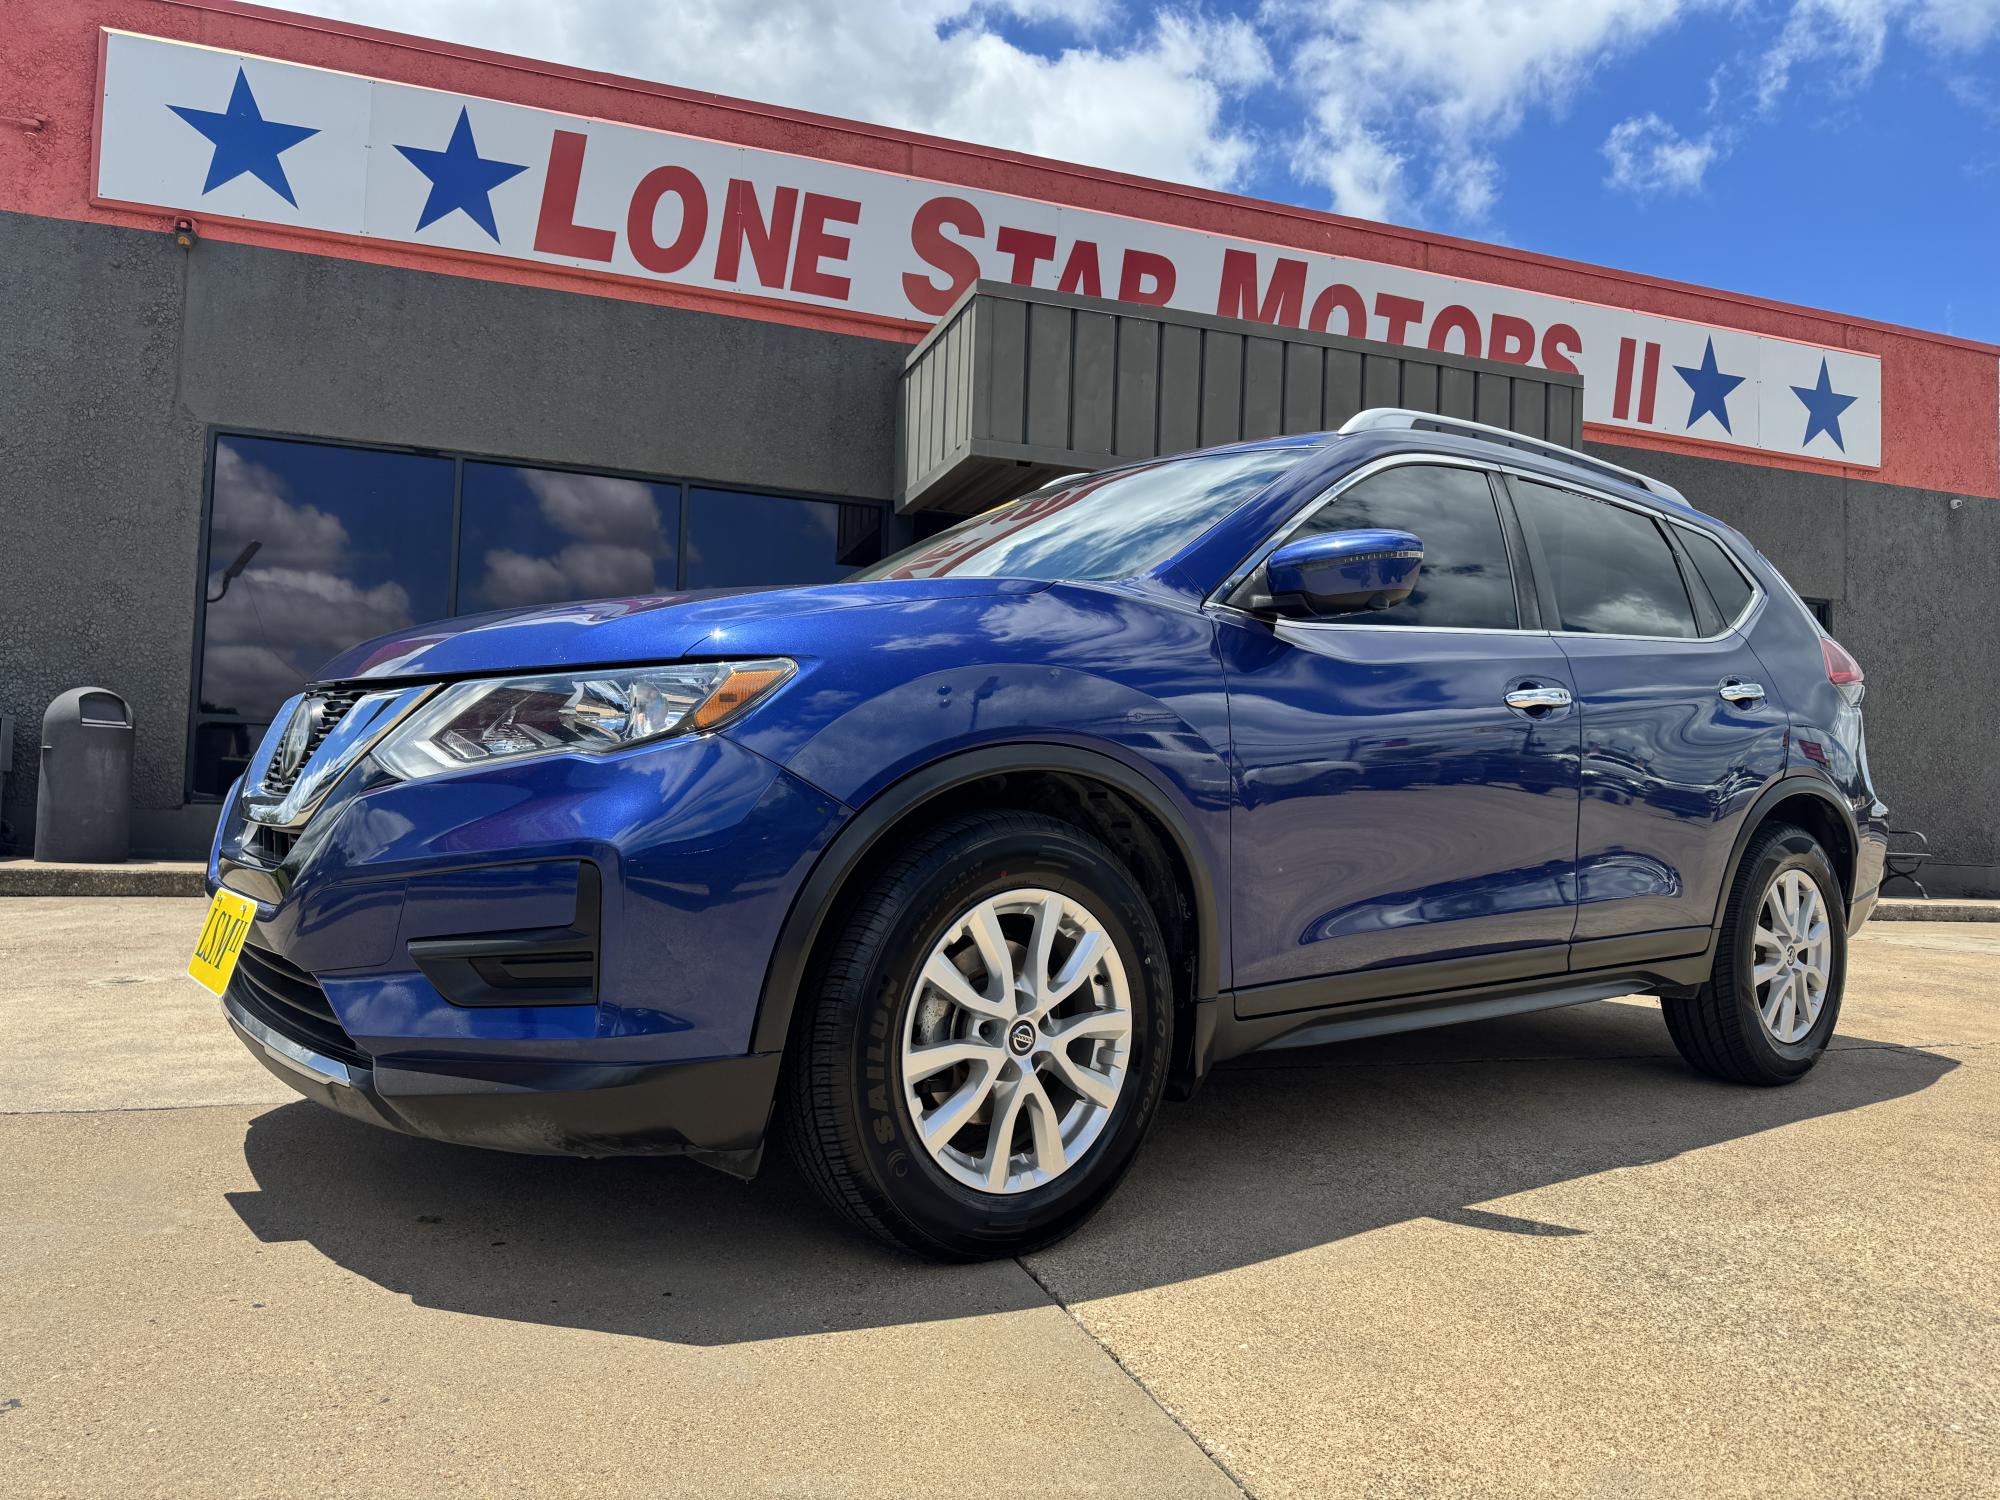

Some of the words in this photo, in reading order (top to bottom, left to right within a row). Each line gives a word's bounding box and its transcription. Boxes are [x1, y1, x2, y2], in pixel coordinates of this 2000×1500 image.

[533, 128, 862, 301] LONE
[901, 196, 1177, 316] STAR
[1216, 248, 1583, 375] MOTORS
[1611, 336, 1662, 425] II
[865, 976, 899, 1145] SAILUN
